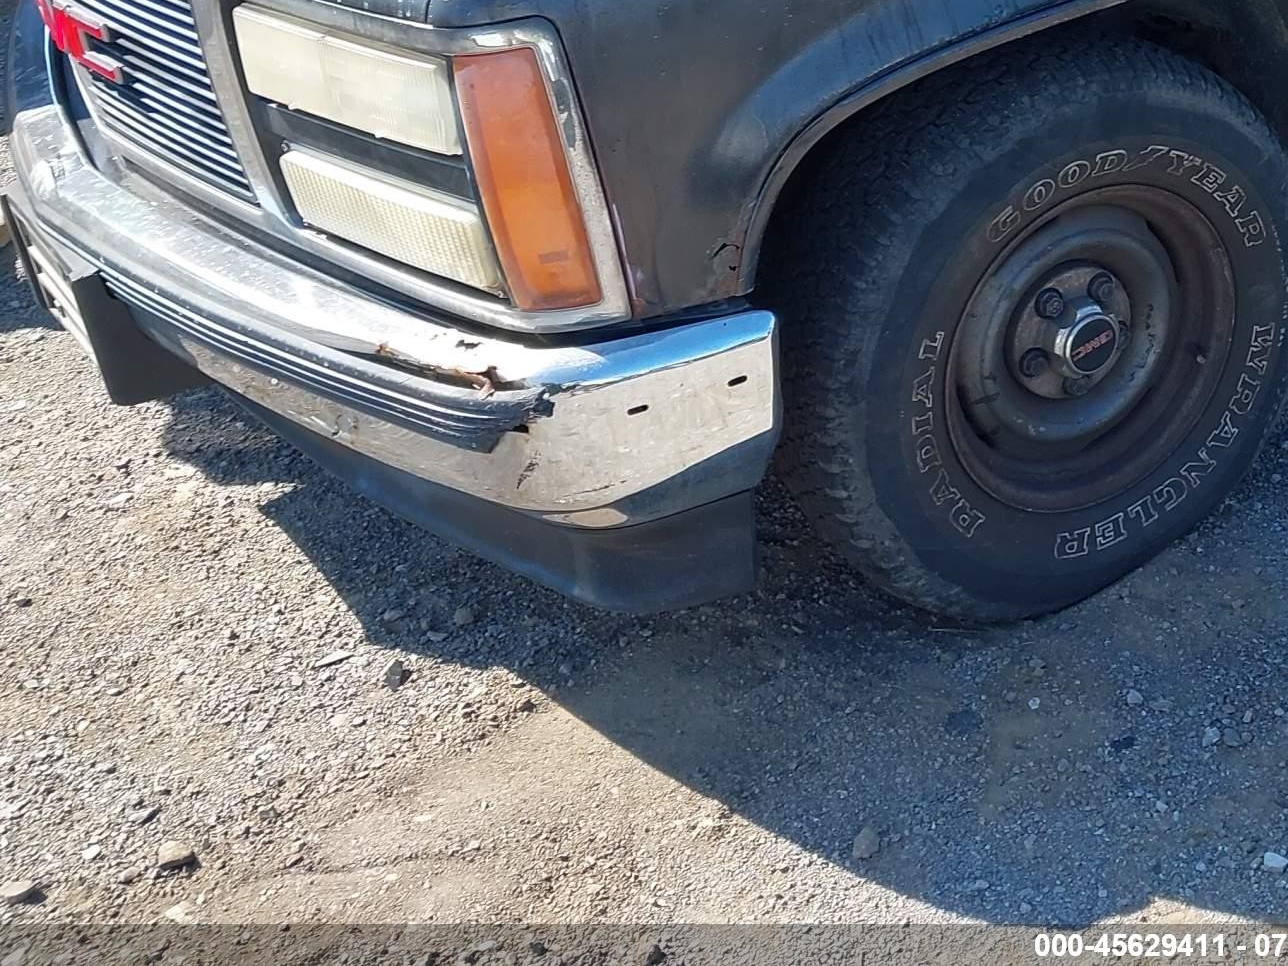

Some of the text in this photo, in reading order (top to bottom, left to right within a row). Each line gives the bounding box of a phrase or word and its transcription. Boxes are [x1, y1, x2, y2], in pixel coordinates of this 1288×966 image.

[910, 330, 986, 538] RADIAL
[1053, 321, 1276, 560] WRANGLER
[1071, 329, 1114, 363] GMC
